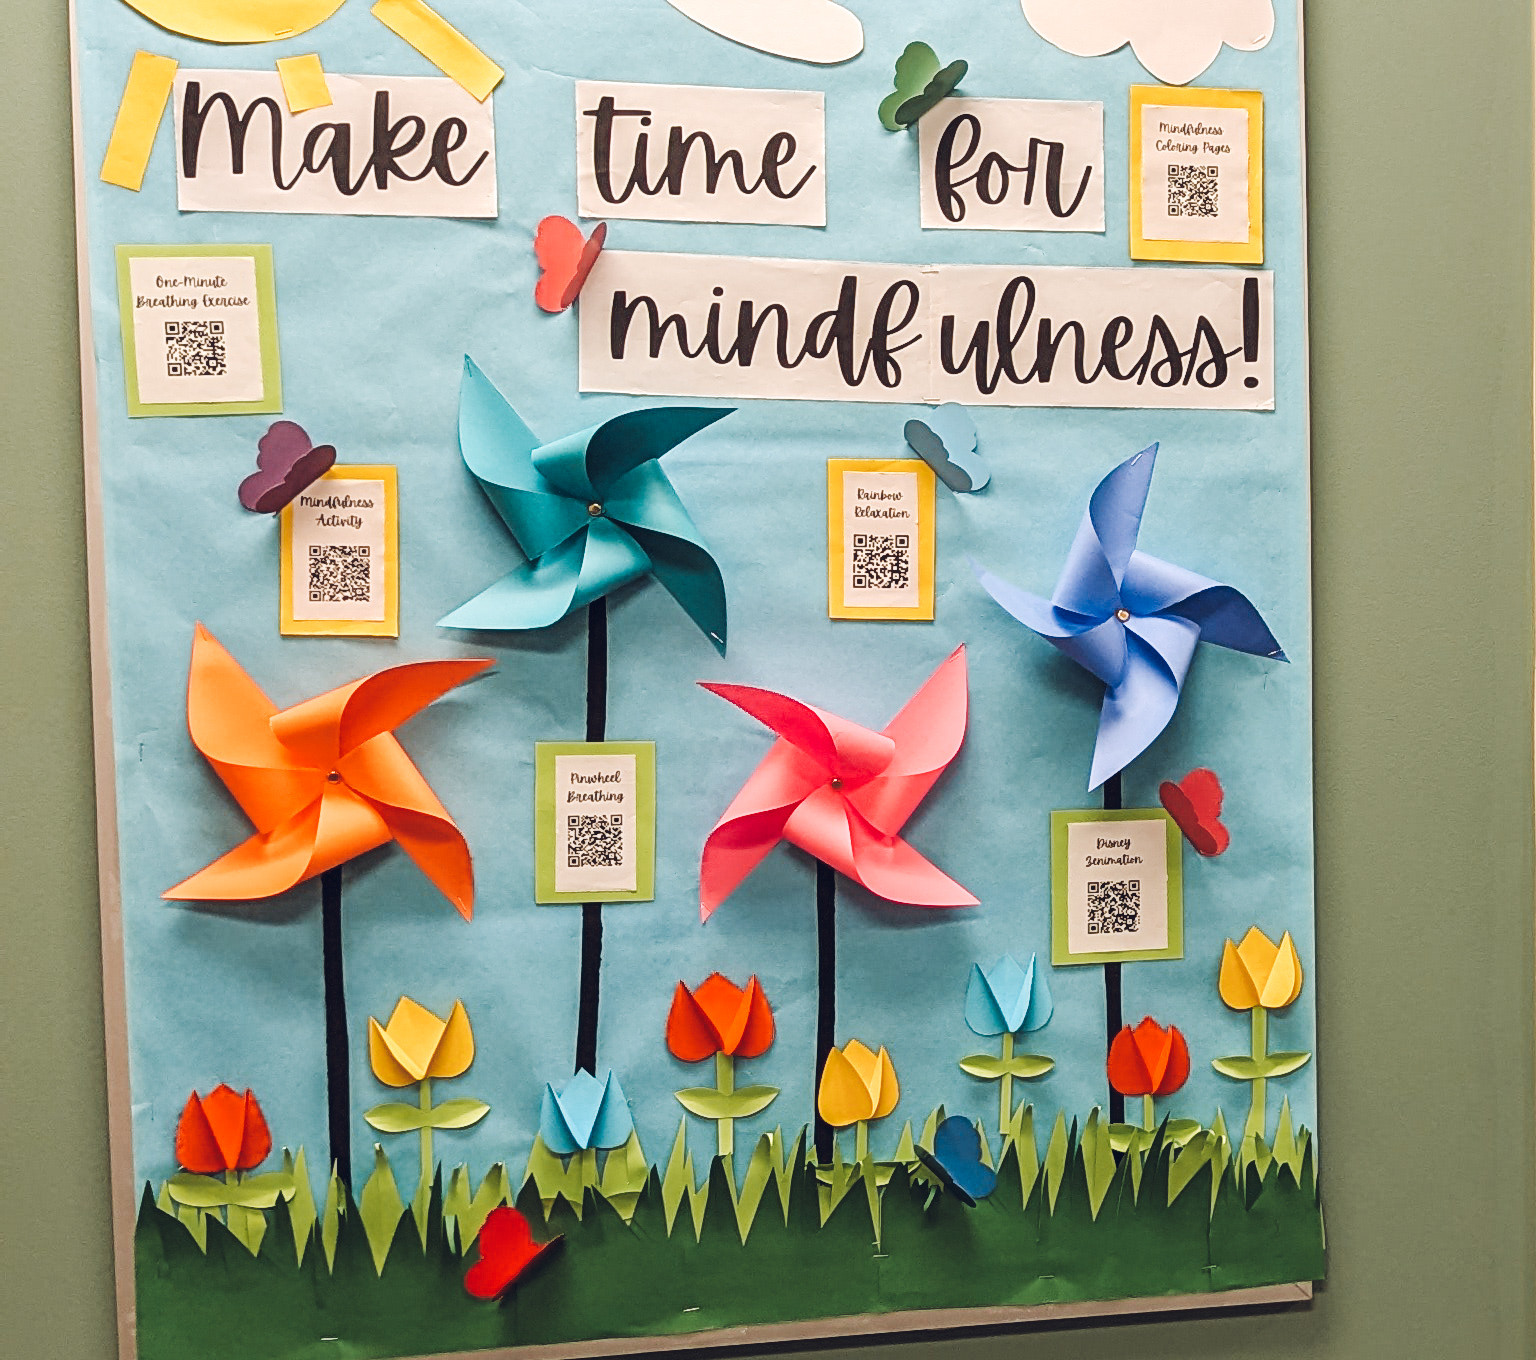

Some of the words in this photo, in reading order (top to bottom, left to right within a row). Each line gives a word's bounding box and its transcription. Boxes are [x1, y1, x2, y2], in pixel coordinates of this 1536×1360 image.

[1159, 121, 1224, 136] Mindfulness
[179, 81, 490, 196] Make
[583, 95, 817, 205] time
[935, 113, 1093, 223] for
[1155, 139, 1198, 154] Coloring
[1202, 141, 1231, 155] Pages
[156, 275, 228, 289] One-Minute
[136, 294, 198, 309] Breathing
[202, 293, 251, 308] Exercise
[300, 494, 374, 508] Mindfulness
[857, 487, 903, 501] Rainbow
[854, 505, 911, 519] Relaxation
[315, 513, 364, 529] Activity
[570, 770, 622, 784] Pinwheel
[566, 790, 624, 803] Breathing
[1096, 837, 1131, 850] Disney
[1085, 853, 1143, 867] Zenimation
